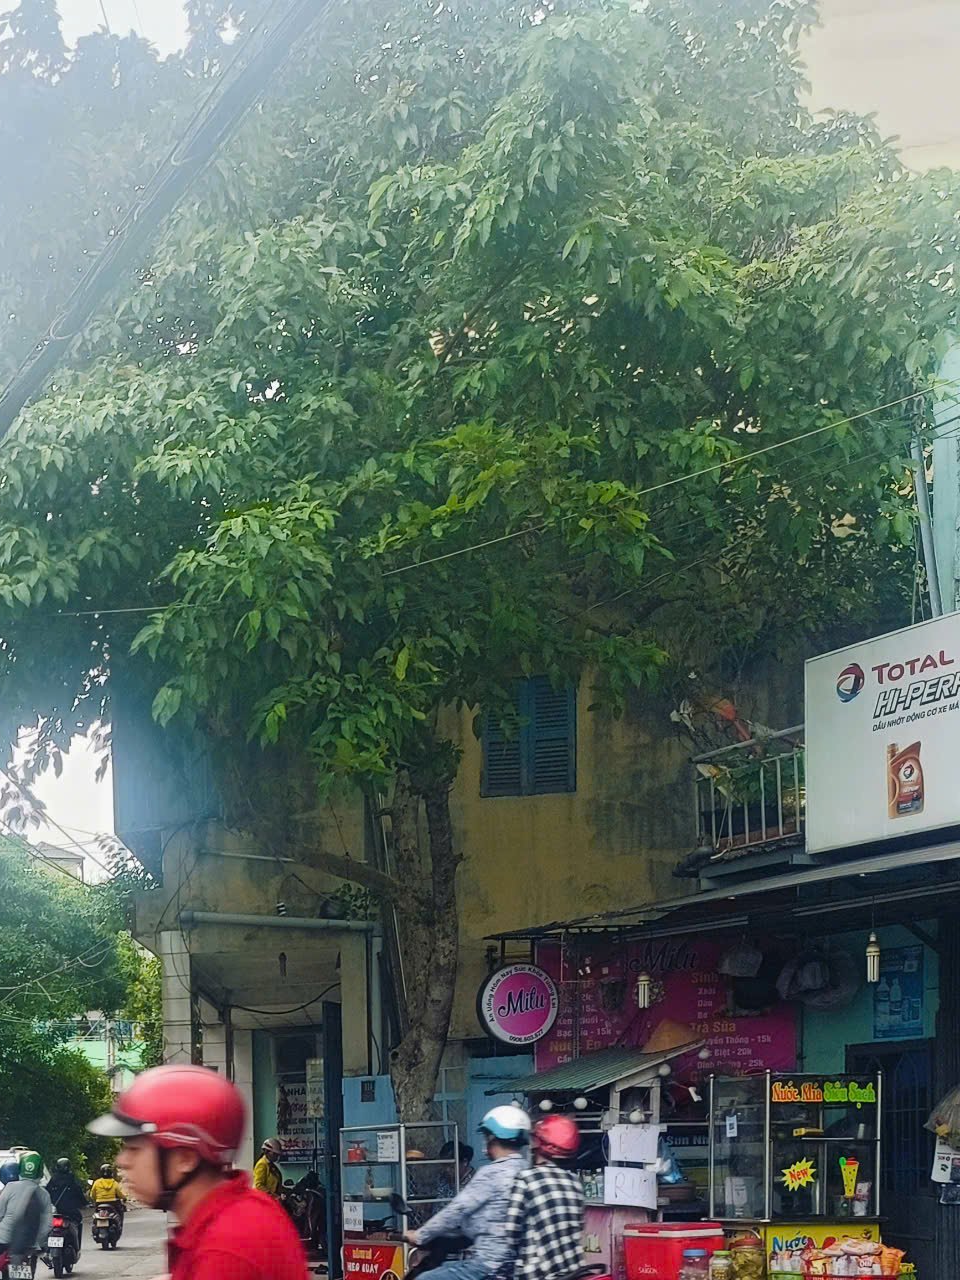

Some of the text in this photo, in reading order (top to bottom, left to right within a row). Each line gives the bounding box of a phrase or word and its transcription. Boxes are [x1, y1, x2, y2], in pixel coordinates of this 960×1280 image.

[871, 650, 954, 685] TOTAL
[938, 704, 948, 714] XE
[497, 986, 544, 1018] Milu
[771, 1080, 800, 1102] Nước
[848, 1081, 876, 1109] Sạch
[788, 1167, 809, 1182] New
[772, 1231, 808, 1252] Nước
